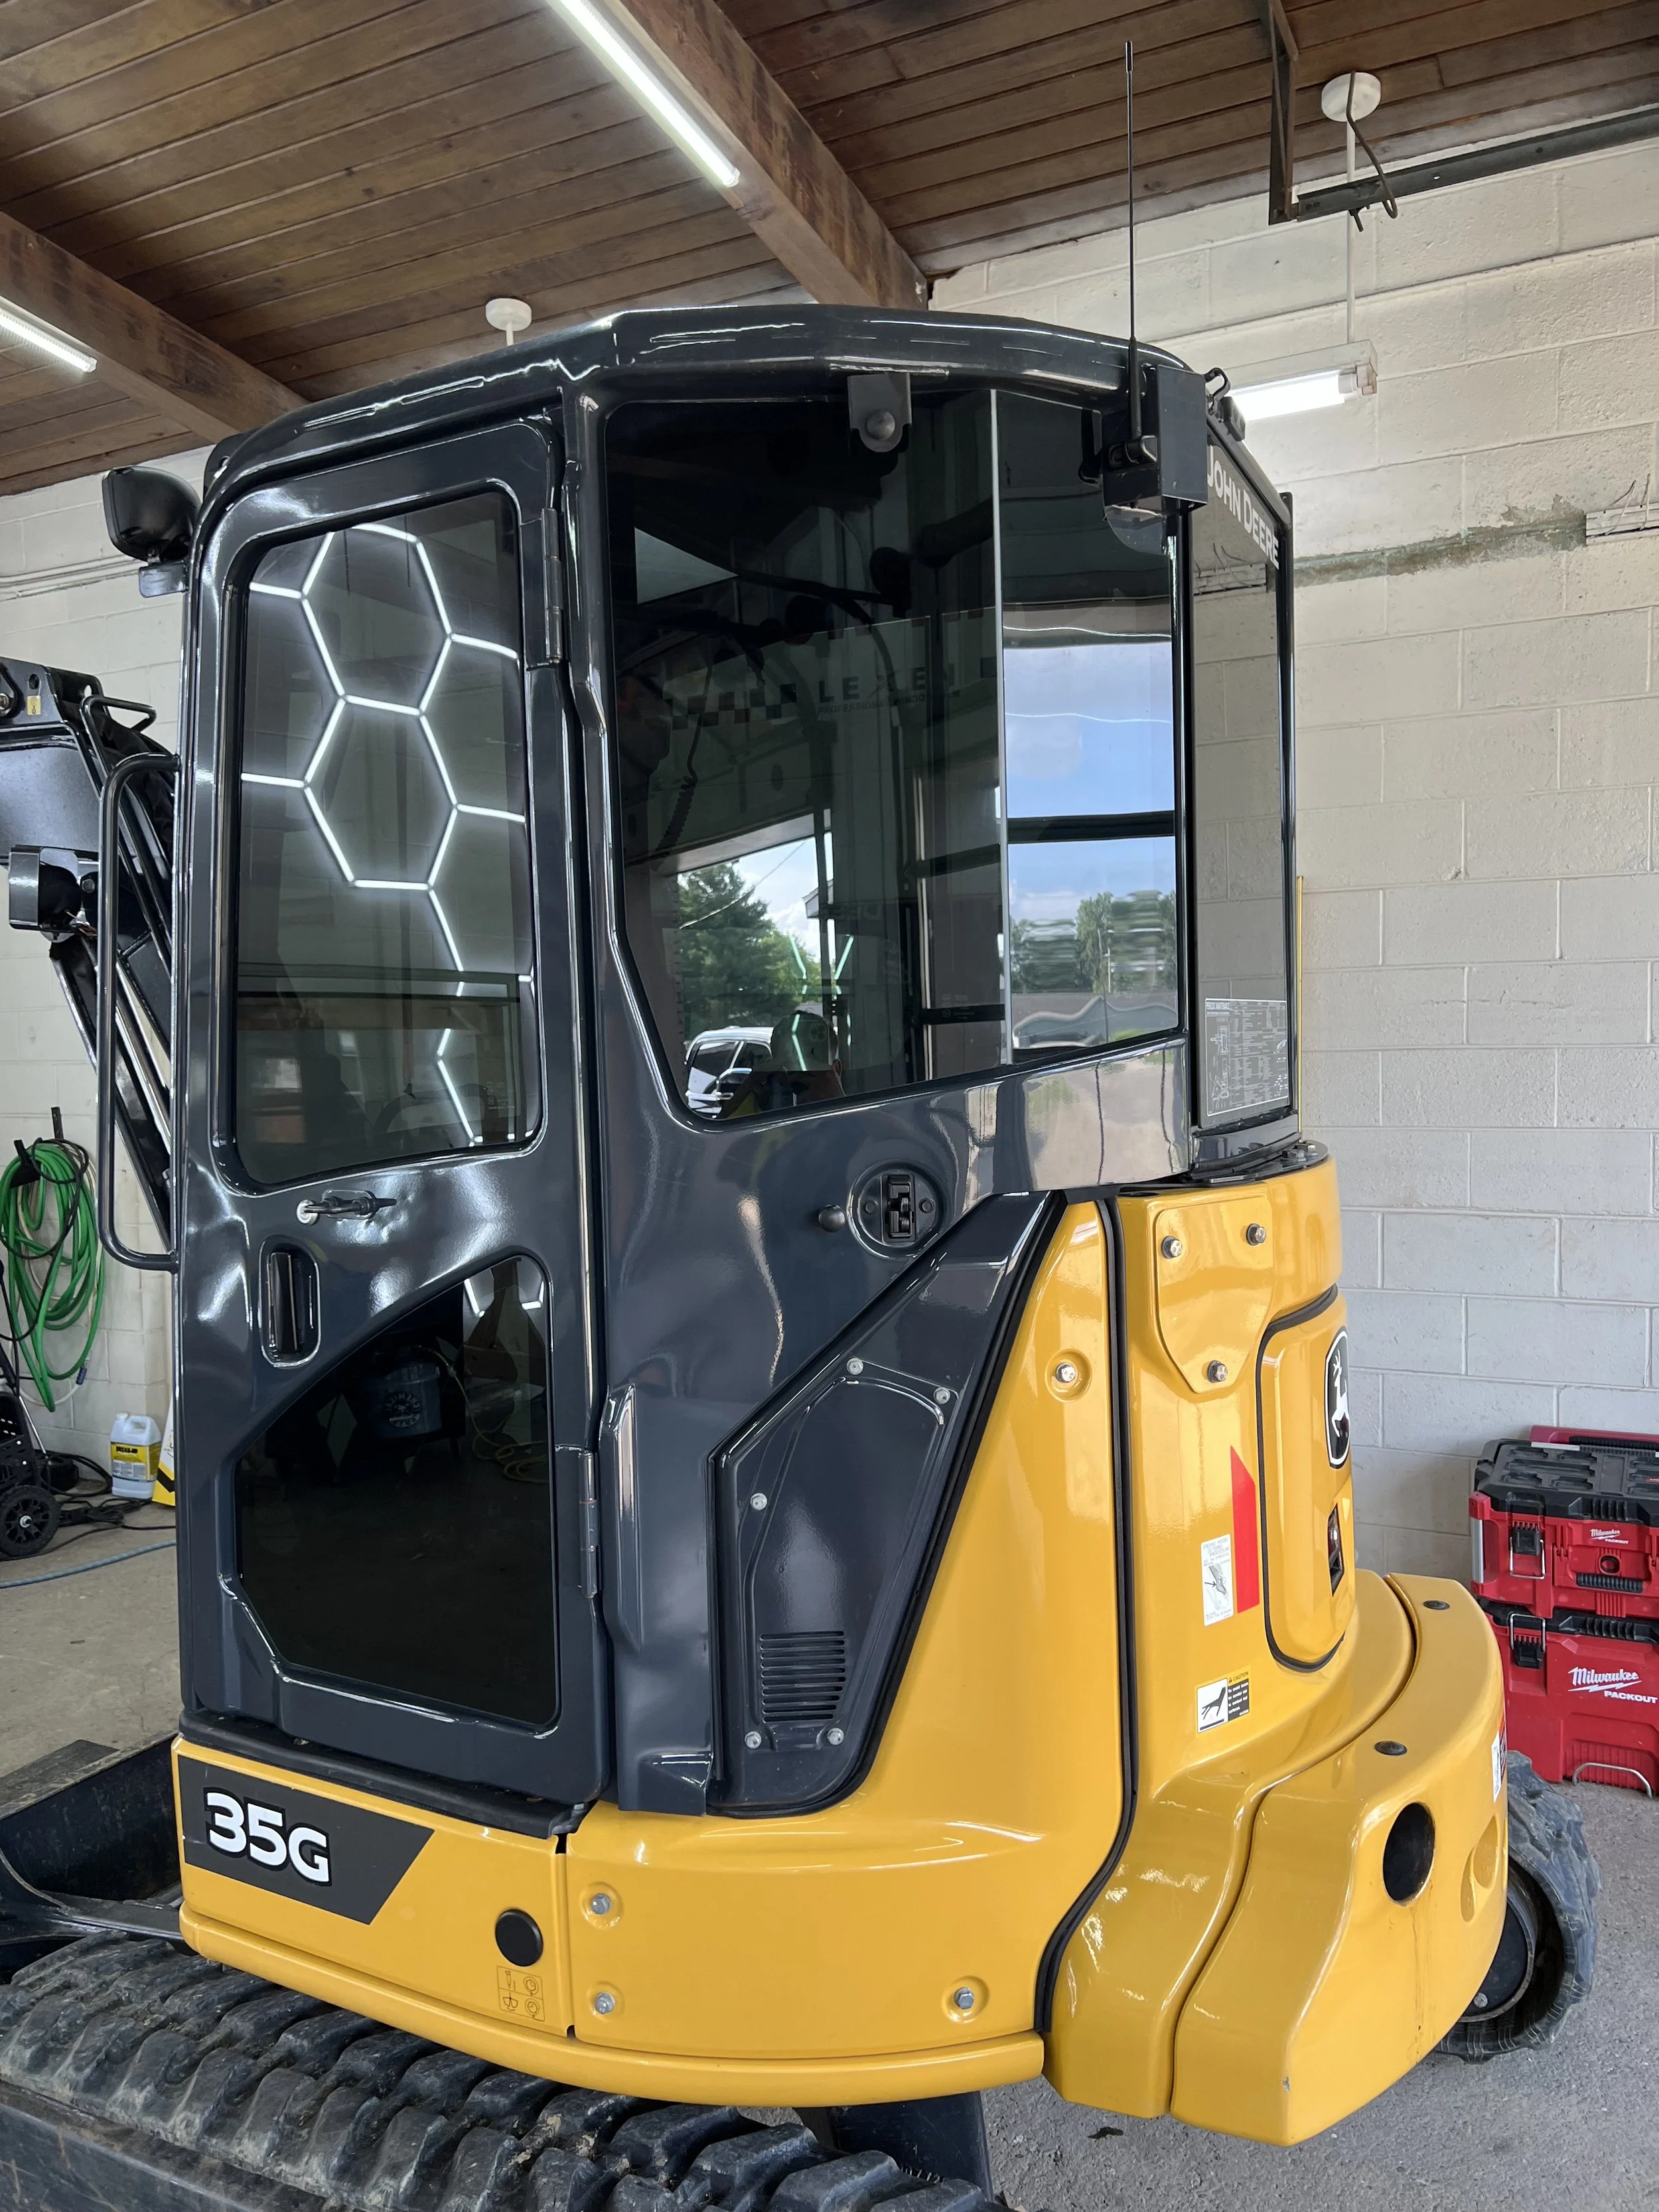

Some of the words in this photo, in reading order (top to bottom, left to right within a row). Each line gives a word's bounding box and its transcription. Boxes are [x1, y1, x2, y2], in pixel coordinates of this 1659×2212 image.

[1207, 445, 1242, 522] JOHN
[1244, 489, 1279, 570] DEERE
[1590, 1528, 1621, 1538] Milwaukee
[1233, 1671, 1249, 1682] CAUTION
[1567, 1666, 1640, 1686] Milwaukee
[1604, 1690, 1658, 1704] PACKOUT
[206, 1791, 330, 1883] 35G
